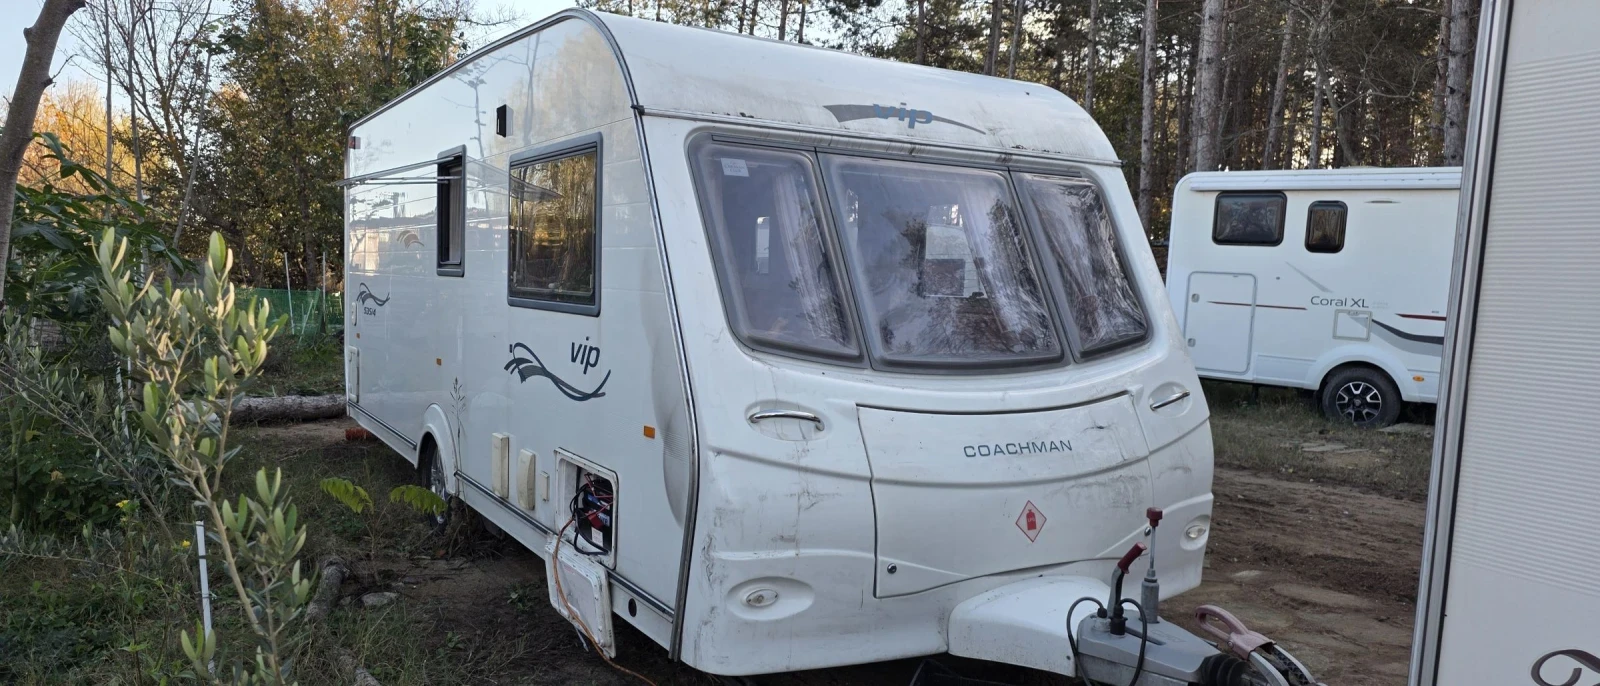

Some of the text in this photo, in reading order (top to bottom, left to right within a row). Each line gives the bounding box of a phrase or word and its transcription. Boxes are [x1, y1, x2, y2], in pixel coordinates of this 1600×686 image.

[873, 102, 933, 129] vip
[1310, 296, 1347, 307] Coral
[1350, 298, 1370, 308] XL
[570, 336, 600, 375] vip
[963, 440, 1073, 458] COACHMAN
